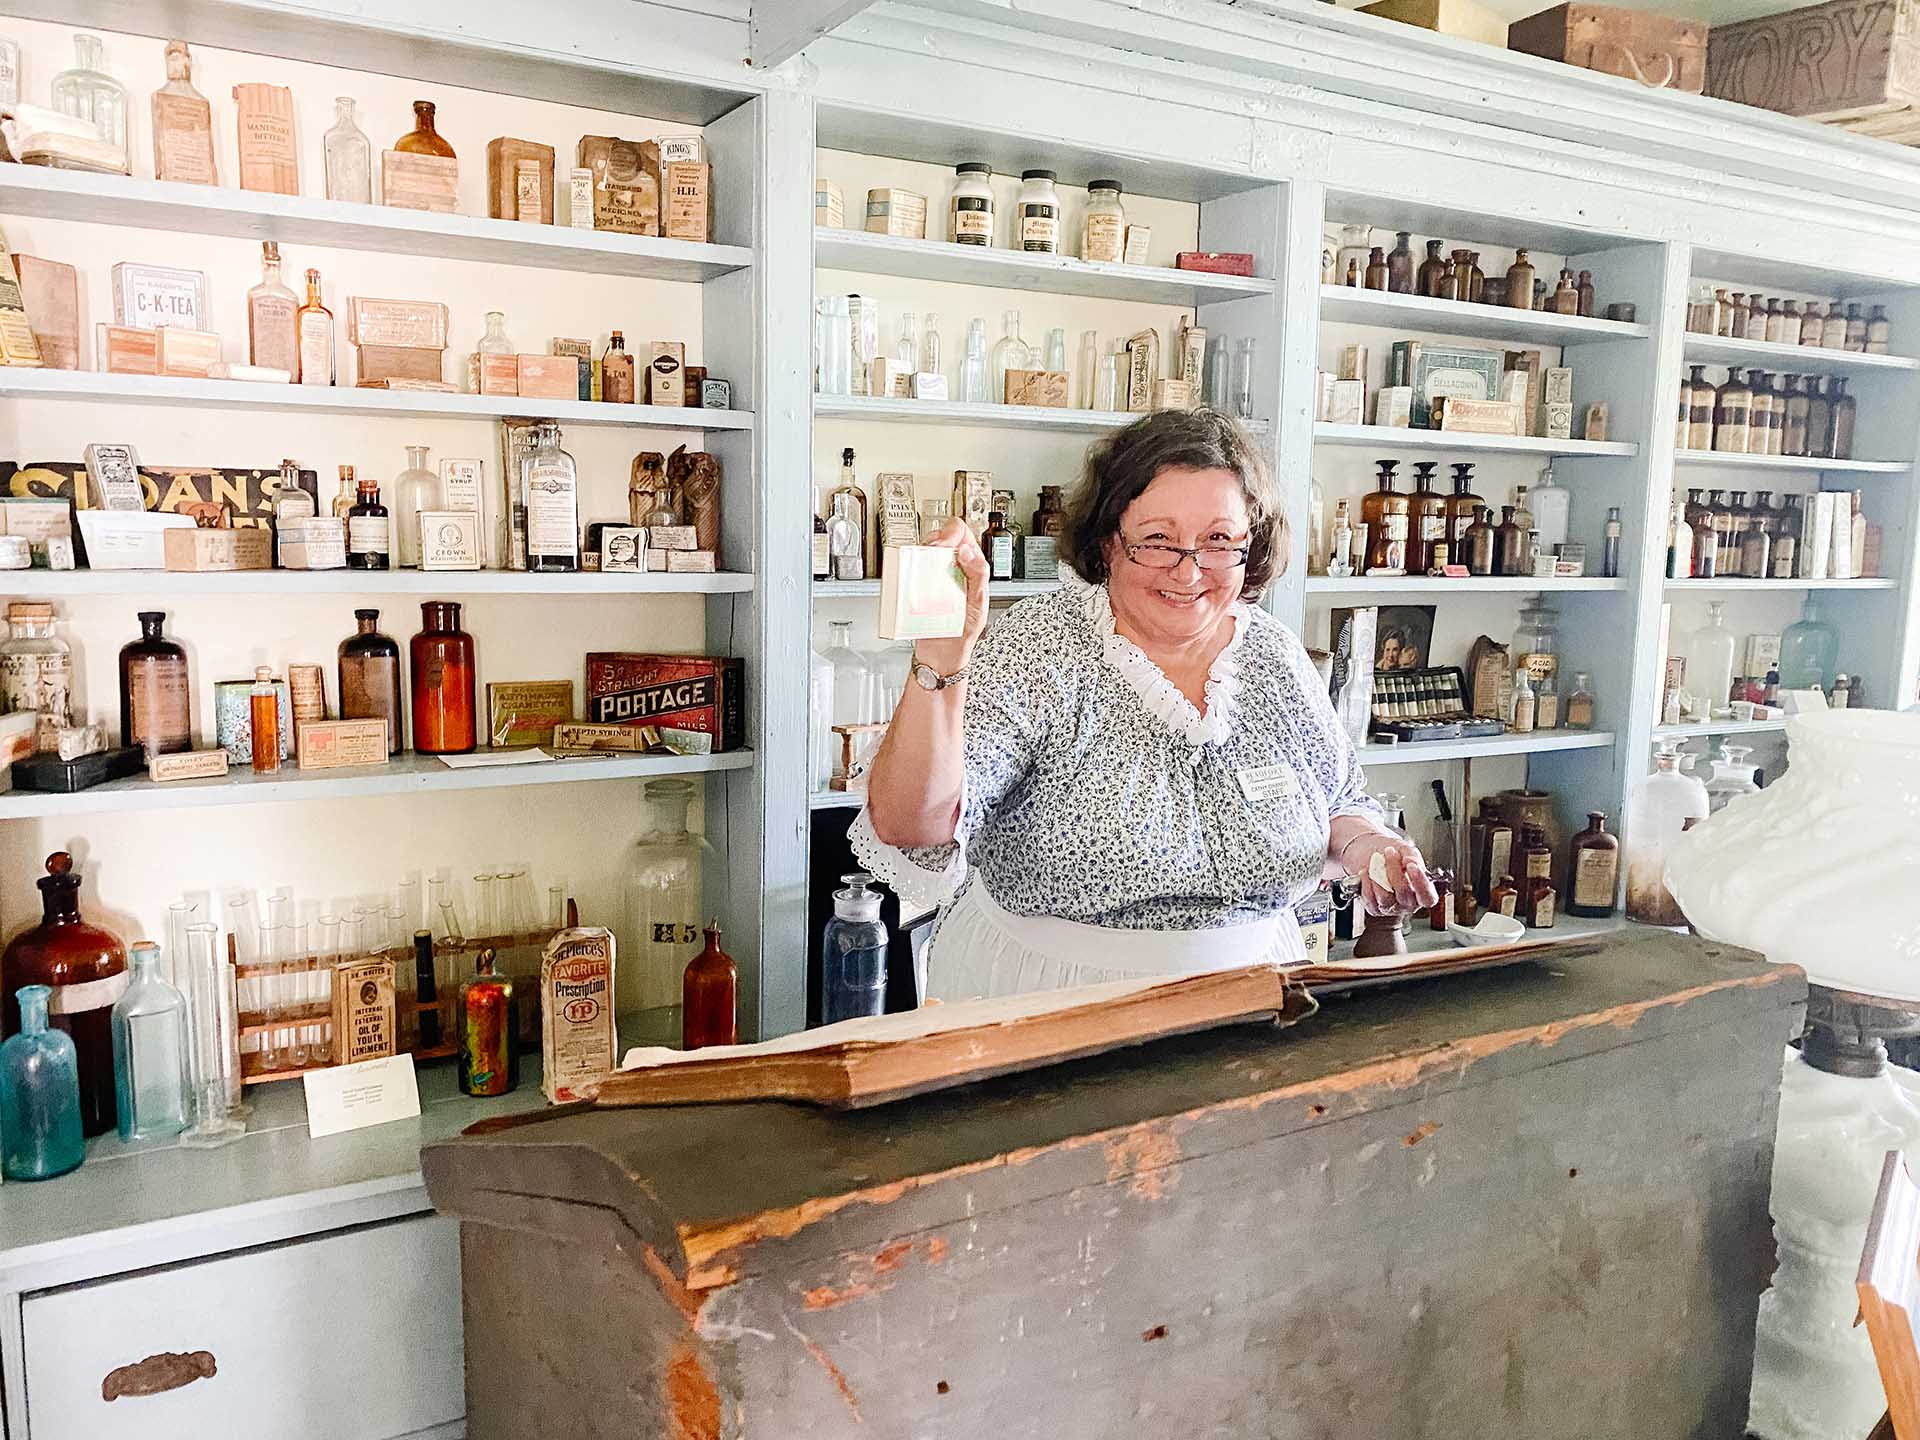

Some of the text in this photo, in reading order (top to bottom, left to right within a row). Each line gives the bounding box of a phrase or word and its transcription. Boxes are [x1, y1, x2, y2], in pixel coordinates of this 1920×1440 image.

[666, 143, 692, 155] KING'S
[676, 187, 699, 196] H.H.
[137, 292, 194, 317] C-K-TEA
[890, 503, 910, 511] PAIN
[887, 511, 914, 519] KILLER
[435, 549, 466, 557] CROWN
[597, 668, 659, 693] STRAIGHT
[600, 681, 706, 722] PORTAGE
[698, 713, 706, 722] A
[598, 727, 633, 737] SYRINGE
[676, 721, 708, 731] MILD
[683, 924, 697, 943] 5
[566, 942, 605, 958] Pierce's
[554, 961, 605, 979] FAVORITE
[555, 977, 606, 998] Prescription
[355, 1005, 383, 1016] INTERNAL
[358, 1023, 381, 1036] OIL OF
[356, 1033, 383, 1046] YOUTH
[351, 1041, 389, 1058] LINIMENT
